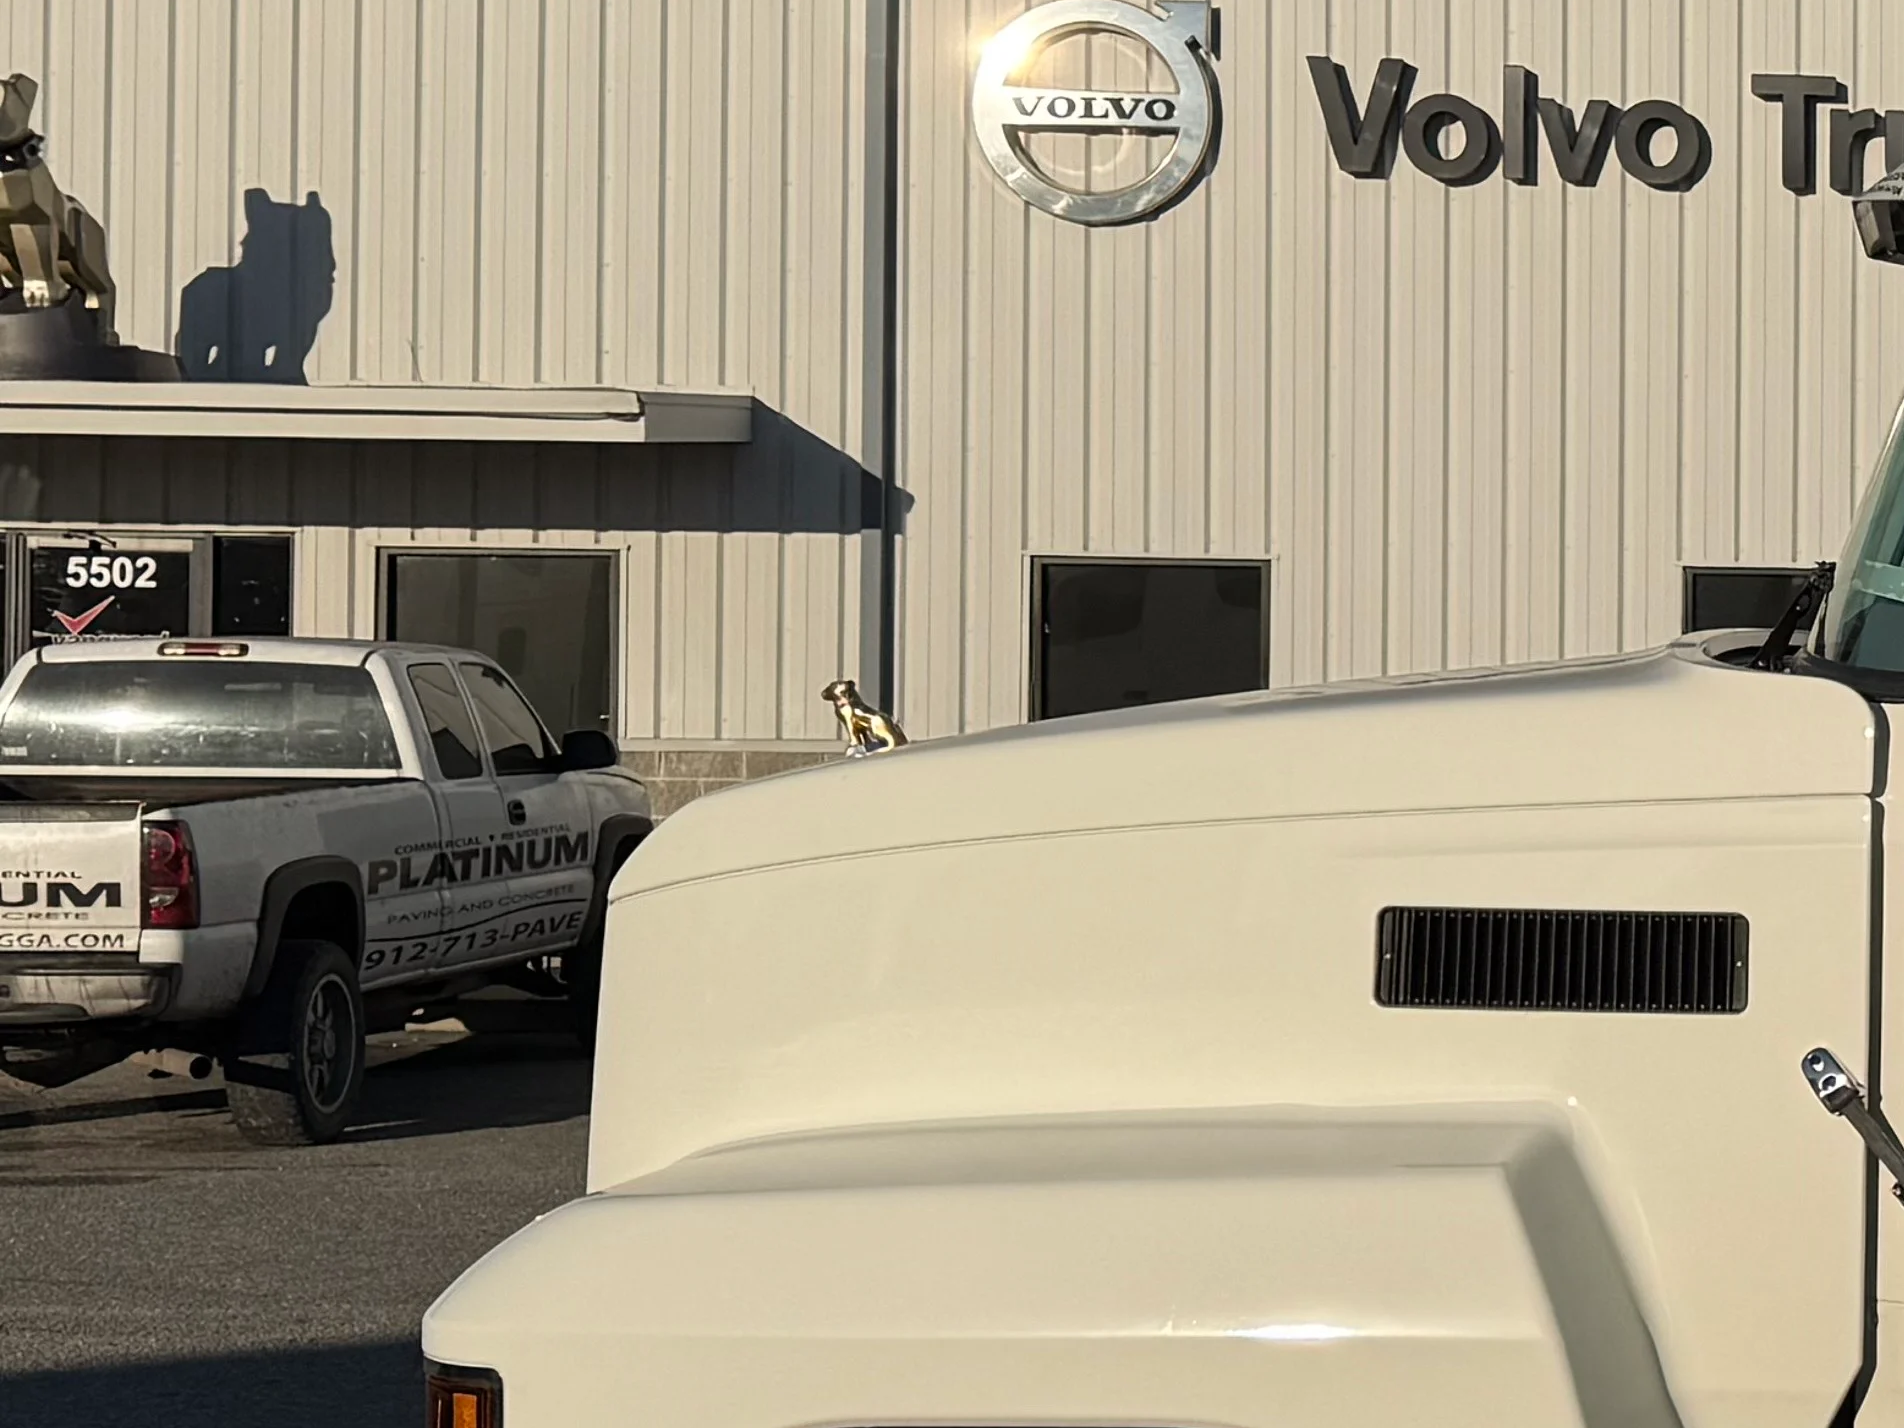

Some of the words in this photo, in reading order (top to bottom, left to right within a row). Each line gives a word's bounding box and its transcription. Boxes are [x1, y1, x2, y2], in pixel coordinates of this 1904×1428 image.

[1012, 95, 1176, 121] VOLVO
[1306, 55, 1711, 191] Volvo
[65, 556, 158, 589] 5502
[394, 836, 481, 855] COMMERCIAL
[501, 823, 571, 841] RESIDENTIAL
[367, 831, 589, 895] PLATINUM
[387, 906, 451, 924] PAVING
[458, 899, 494, 914] AND
[498, 883, 575, 905] CONCRETE
[364, 911, 583, 970] 912-713-PAVE
